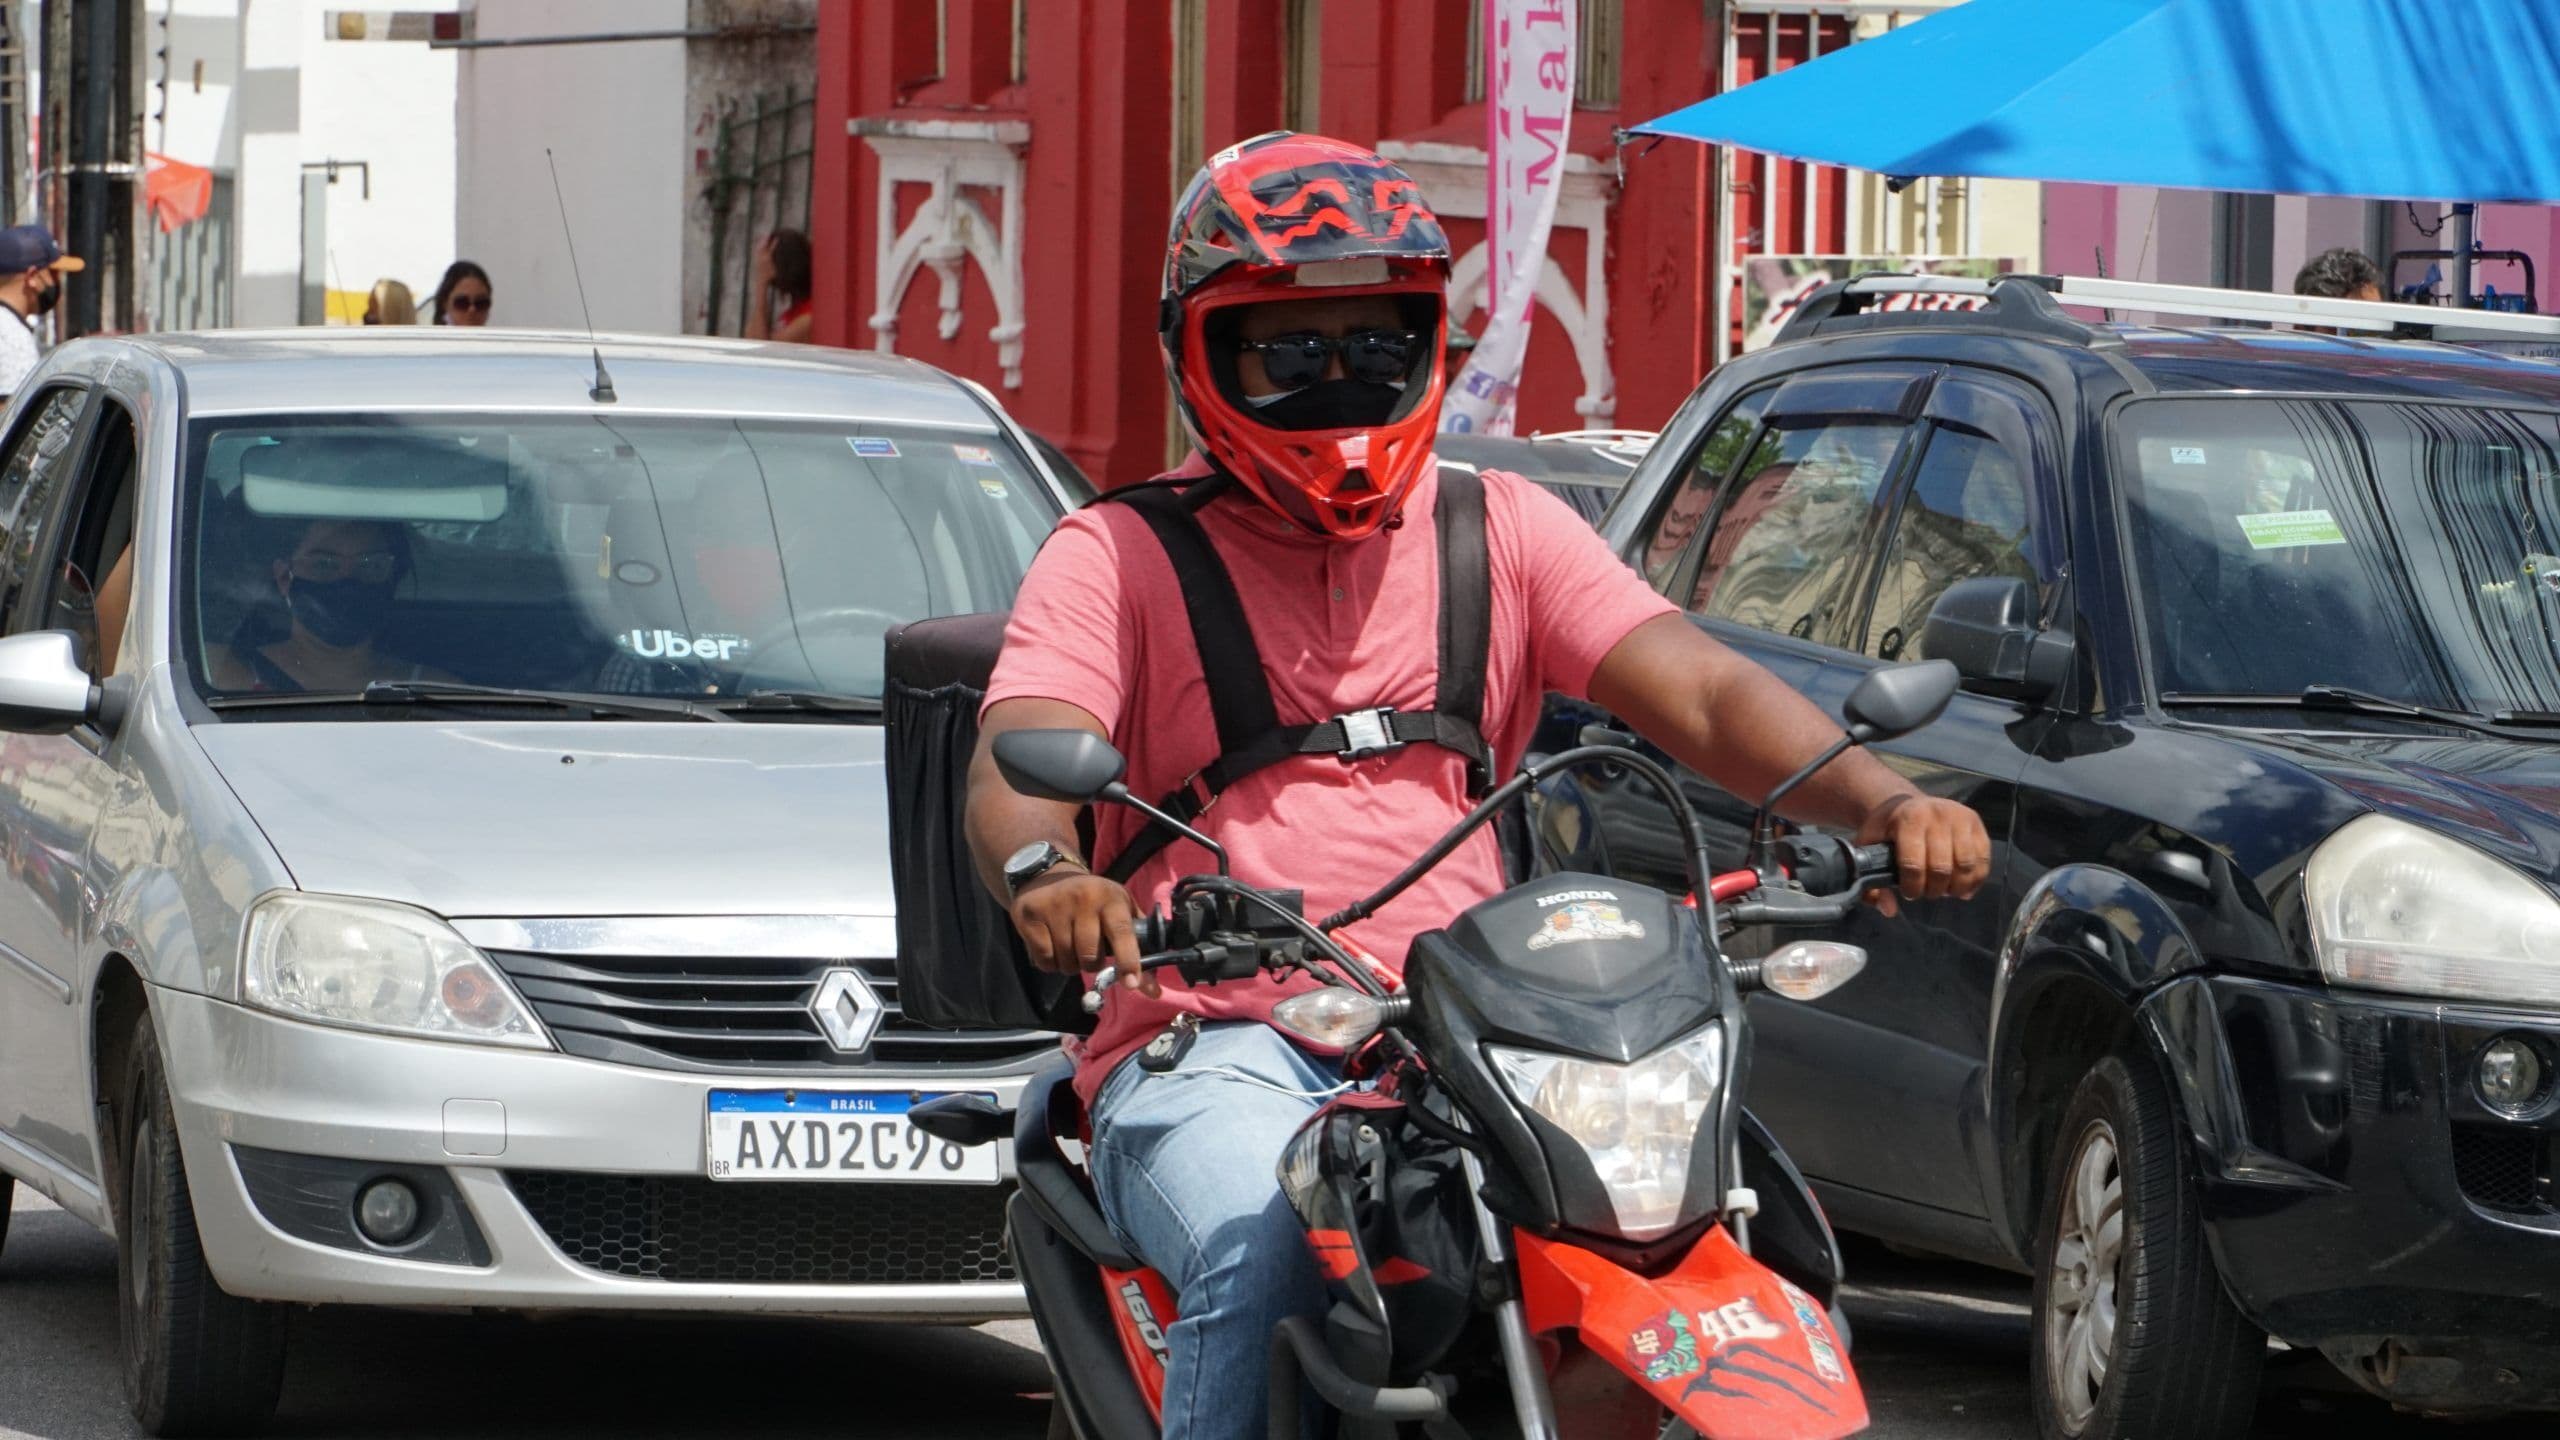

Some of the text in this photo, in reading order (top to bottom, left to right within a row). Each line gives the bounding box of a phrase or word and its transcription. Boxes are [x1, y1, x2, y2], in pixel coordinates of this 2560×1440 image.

[631, 629, 739, 660] Uber
[1535, 890, 1618, 908] HONDA
[830, 1098, 876, 1111] BRASIL
[714, 1160, 730, 1175] BR
[1698, 1296, 1786, 1351] 46
[1631, 1328, 1661, 1355] 46
